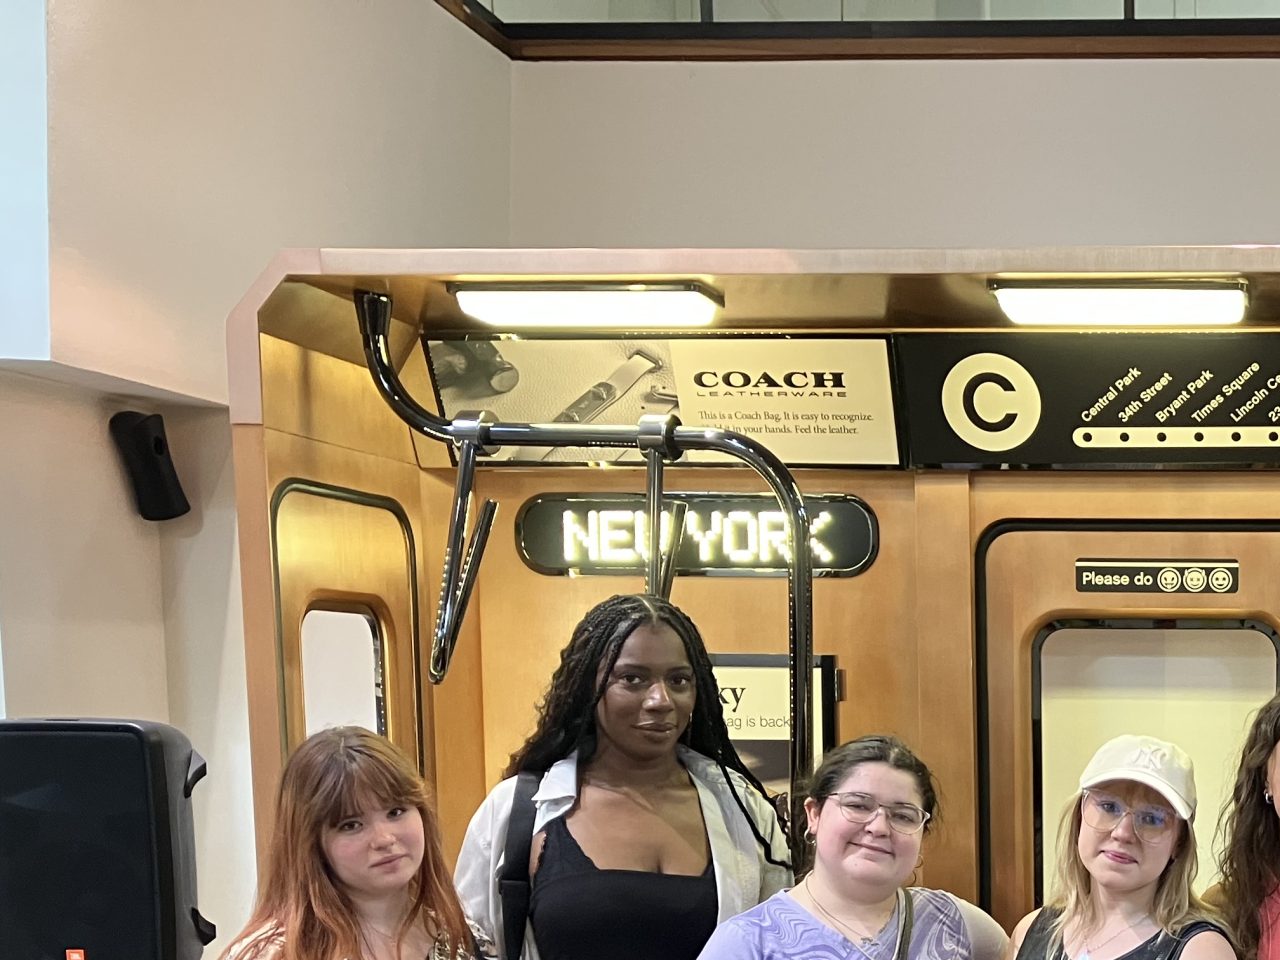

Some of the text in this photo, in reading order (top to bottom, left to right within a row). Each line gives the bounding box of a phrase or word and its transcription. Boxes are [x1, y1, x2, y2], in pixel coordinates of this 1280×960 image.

[694, 371, 845, 388] COACH
[1081, 367, 1141, 422] Central Park
[1155, 369, 1214, 423] Bryant Park
[1191, 362, 1260, 422] Times Square
[963, 372, 1018, 433] C
[1118, 372, 1173, 422] 34th Street
[1230, 388, 1269, 422] Lincoln
[698, 410, 717, 420] This
[719, 410, 726, 420] is
[734, 410, 762, 420] Coach
[784, 411, 790, 420] It
[792, 412, 799, 420] is
[801, 413, 818, 423] easy
[820, 412, 830, 420] to
[831, 412, 874, 423] recognize.
[744, 426, 762, 435] your
[764, 424, 792, 433] hands.
[795, 425, 811, 433] Feel
[813, 425, 827, 433] the
[828, 425, 859, 434] leather.
[1082, 571, 1153, 586] Please do
[727, 715, 790, 729] ag is back
